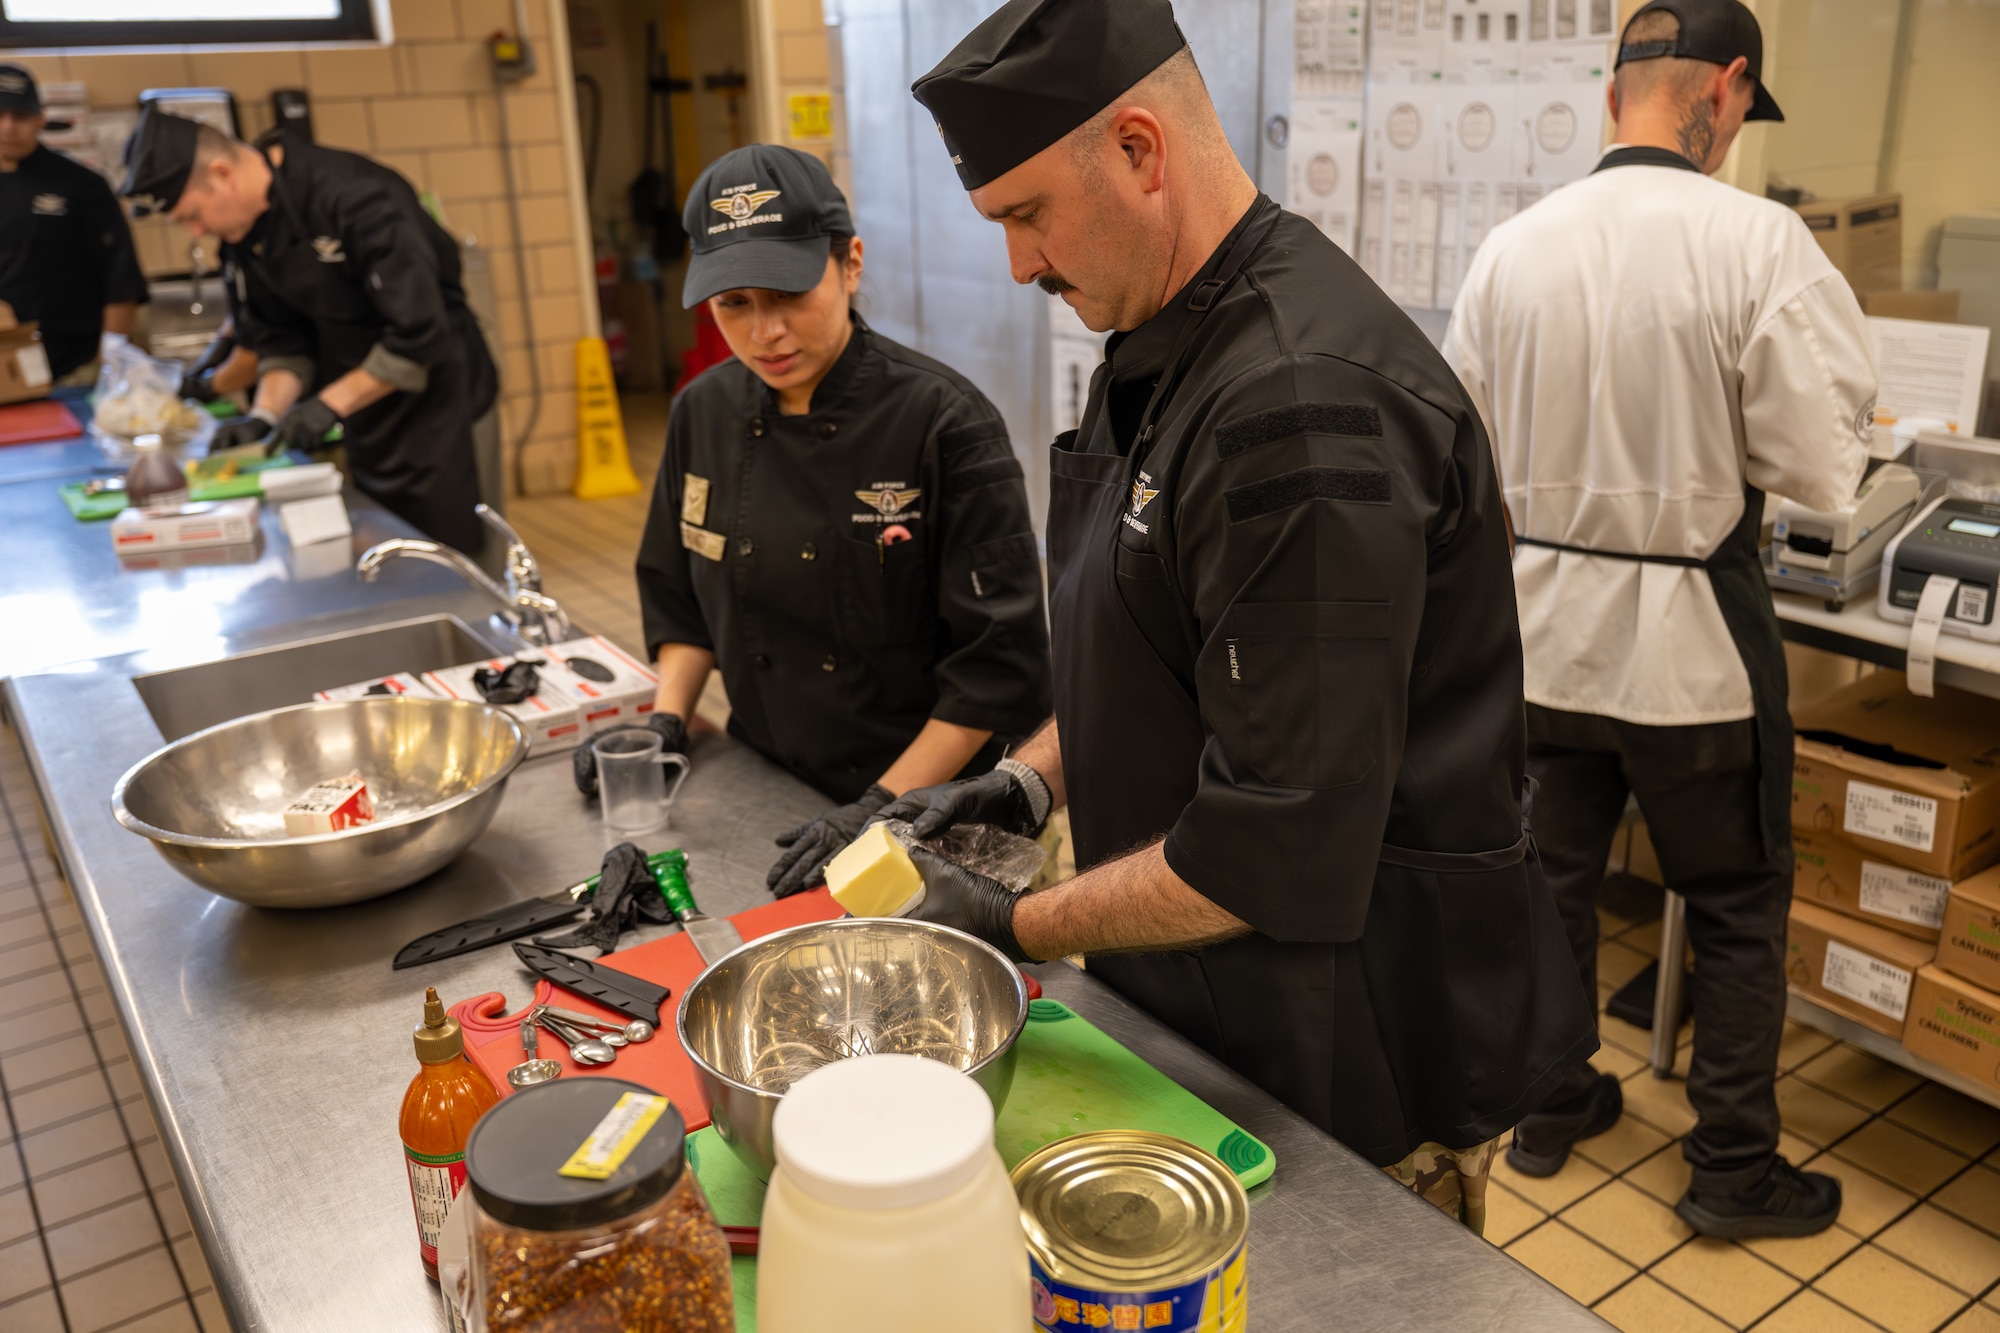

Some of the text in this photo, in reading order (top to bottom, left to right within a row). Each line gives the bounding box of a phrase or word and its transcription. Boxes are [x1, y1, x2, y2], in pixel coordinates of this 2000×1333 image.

[734, 182, 758, 193] FORCE
[707, 222, 728, 235] FOOD
[736, 213, 783, 228] BEVERAGE
[1228, 644, 1241, 680] neuchef
[1951, 935, 1975, 953] CAN
[1918, 1016, 1981, 1051] CAN LINERS
